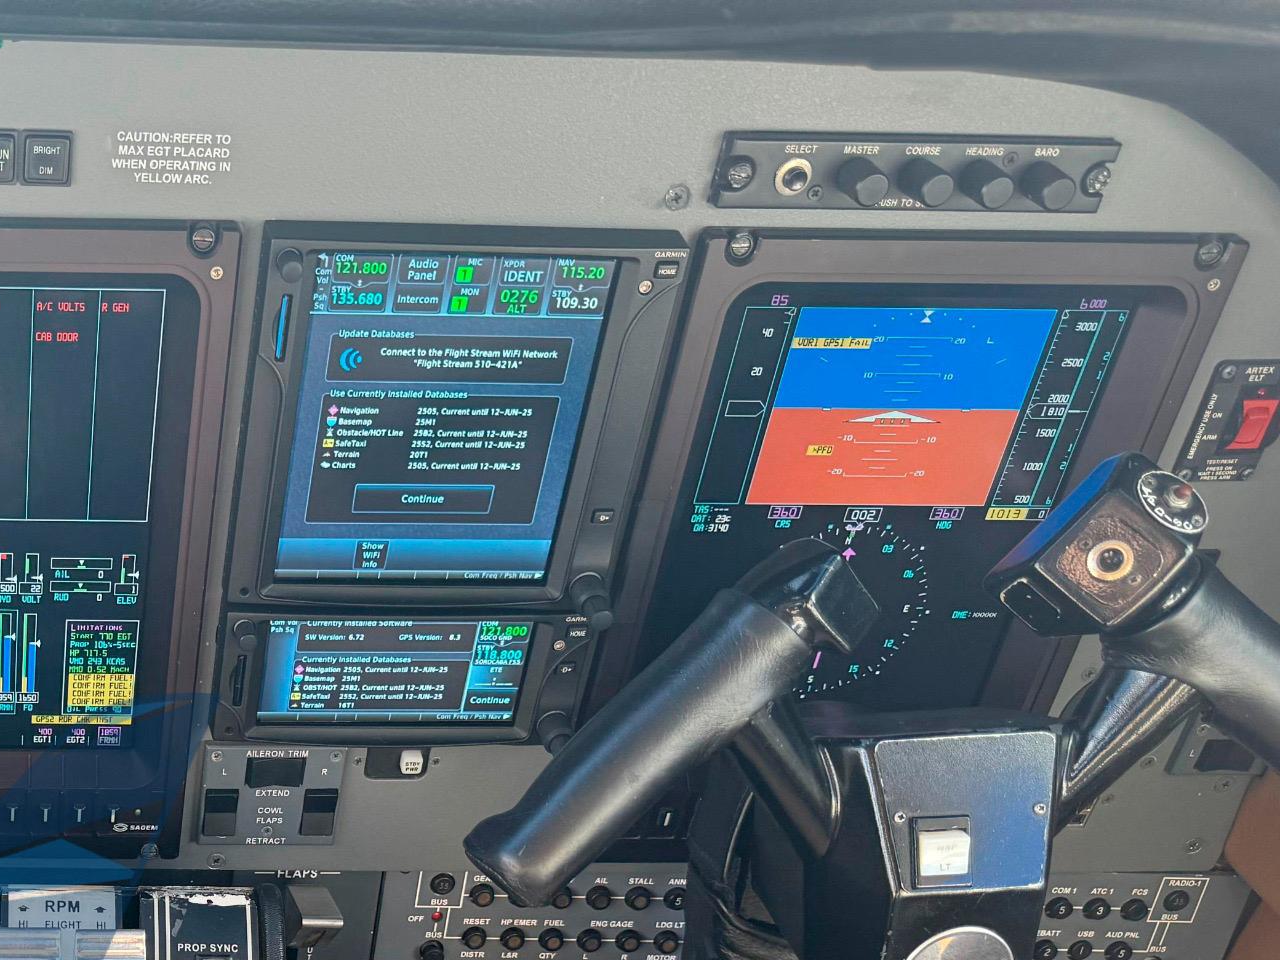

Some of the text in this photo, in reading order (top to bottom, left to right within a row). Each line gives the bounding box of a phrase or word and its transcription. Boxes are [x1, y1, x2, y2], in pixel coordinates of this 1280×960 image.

[117, 132, 231, 144] CAUTION:REFER TO
[33, 146, 60, 155] BRIGHT
[119, 146, 229, 158] MAX EGT PLACARD
[785, 145, 818, 154] SELECT
[844, 146, 879, 155] MASTER
[906, 146, 940, 155] COURSE
[965, 148, 1004, 156] HEADING
[1035, 148, 1060, 156] BARO
[112, 159, 231, 171] WHEN OPERATING IN
[134, 173, 212, 184] YELLOW ARC.
[336, 262, 387, 274] 121.800
[409, 259, 439, 269] Audio
[408, 271, 436, 281] Panel
[504, 271, 543, 282] IDENT
[561, 267, 605, 279] 115.20
[332, 293, 383, 305] 135.680
[397, 295, 438, 304] Intercom
[501, 290, 538, 303] 0276
[36, 302, 85, 312] A/C VOLTS
[556, 298, 598, 309] 109.30
[507, 305, 527, 314] ALT
[35, 332, 78, 342] CAB DOOR
[339, 330, 369, 338] Update
[381, 348, 415, 357] Connect
[418, 349, 426, 357] to
[428, 349, 442, 357] the
[445, 349, 469, 358] Flight
[471, 350, 501, 358] Stream
[523, 351, 557, 359] Network
[341, 406, 379, 416] Navigation
[441, 408, 469, 416] Current
[402, 494, 444, 504] Continue
[849, 510, 876, 520] 002
[470, 696, 510, 704] Continue
[277, 870, 318, 878] FLAPS
[45, 901, 80, 913] RPM
[178, 943, 238, 952] PROP SYNC
